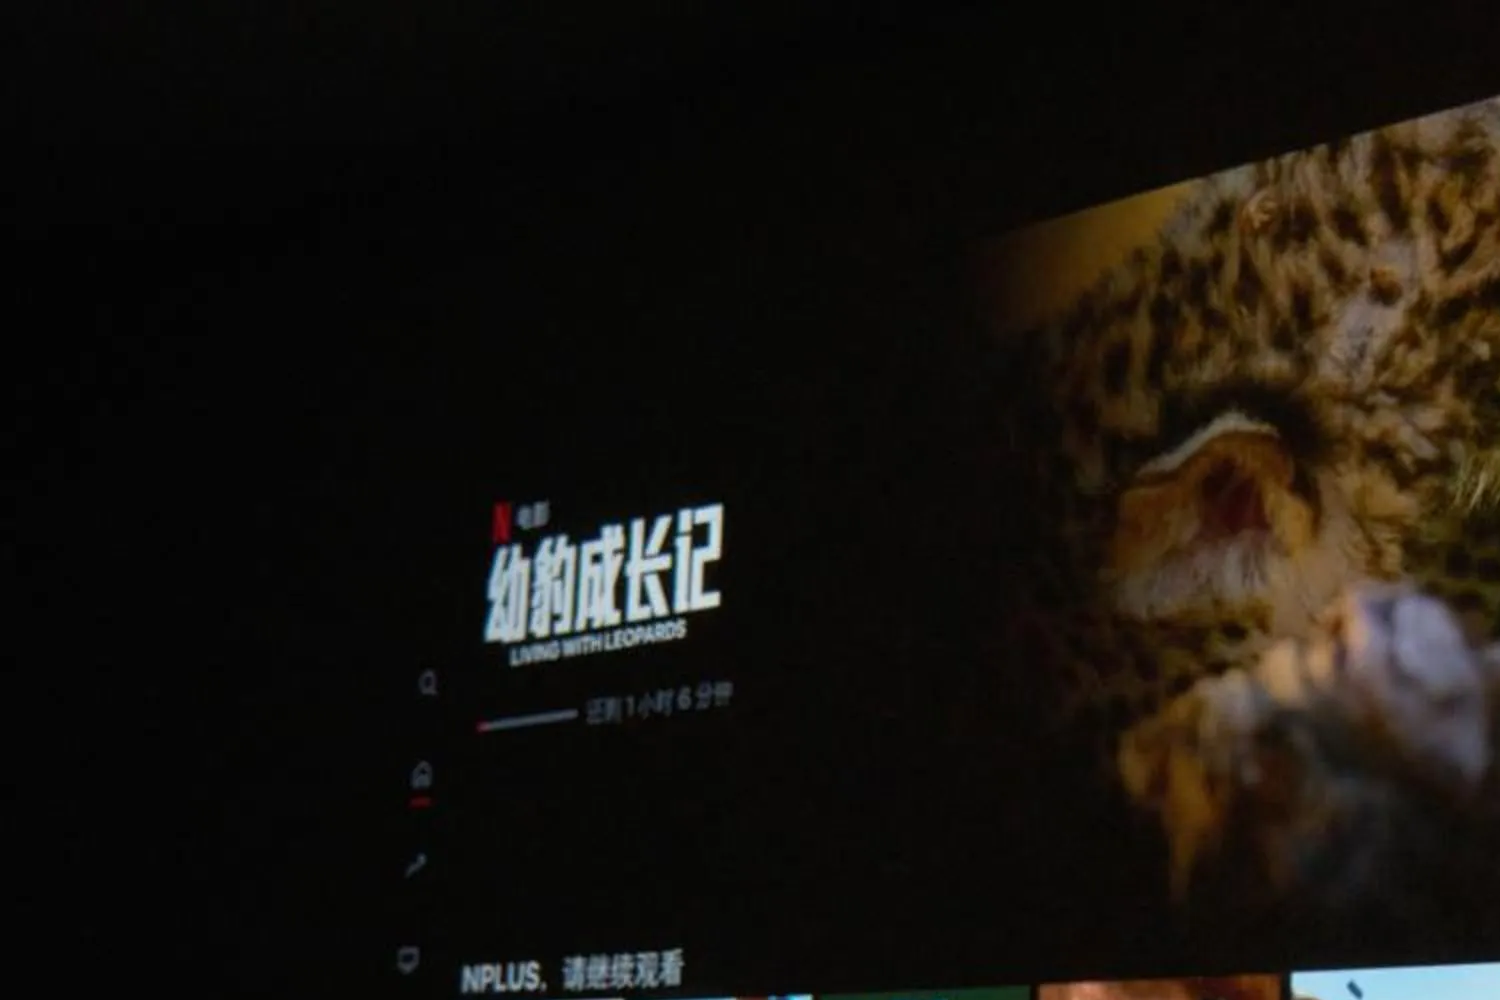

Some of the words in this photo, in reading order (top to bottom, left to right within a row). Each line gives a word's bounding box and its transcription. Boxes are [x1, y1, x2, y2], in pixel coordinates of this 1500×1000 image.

[484, 502, 724, 643] 幼豹成长记
[508, 640, 560, 667] LIVING
[561, 632, 602, 658] WITH
[603, 618, 688, 650] LEOPARDS
